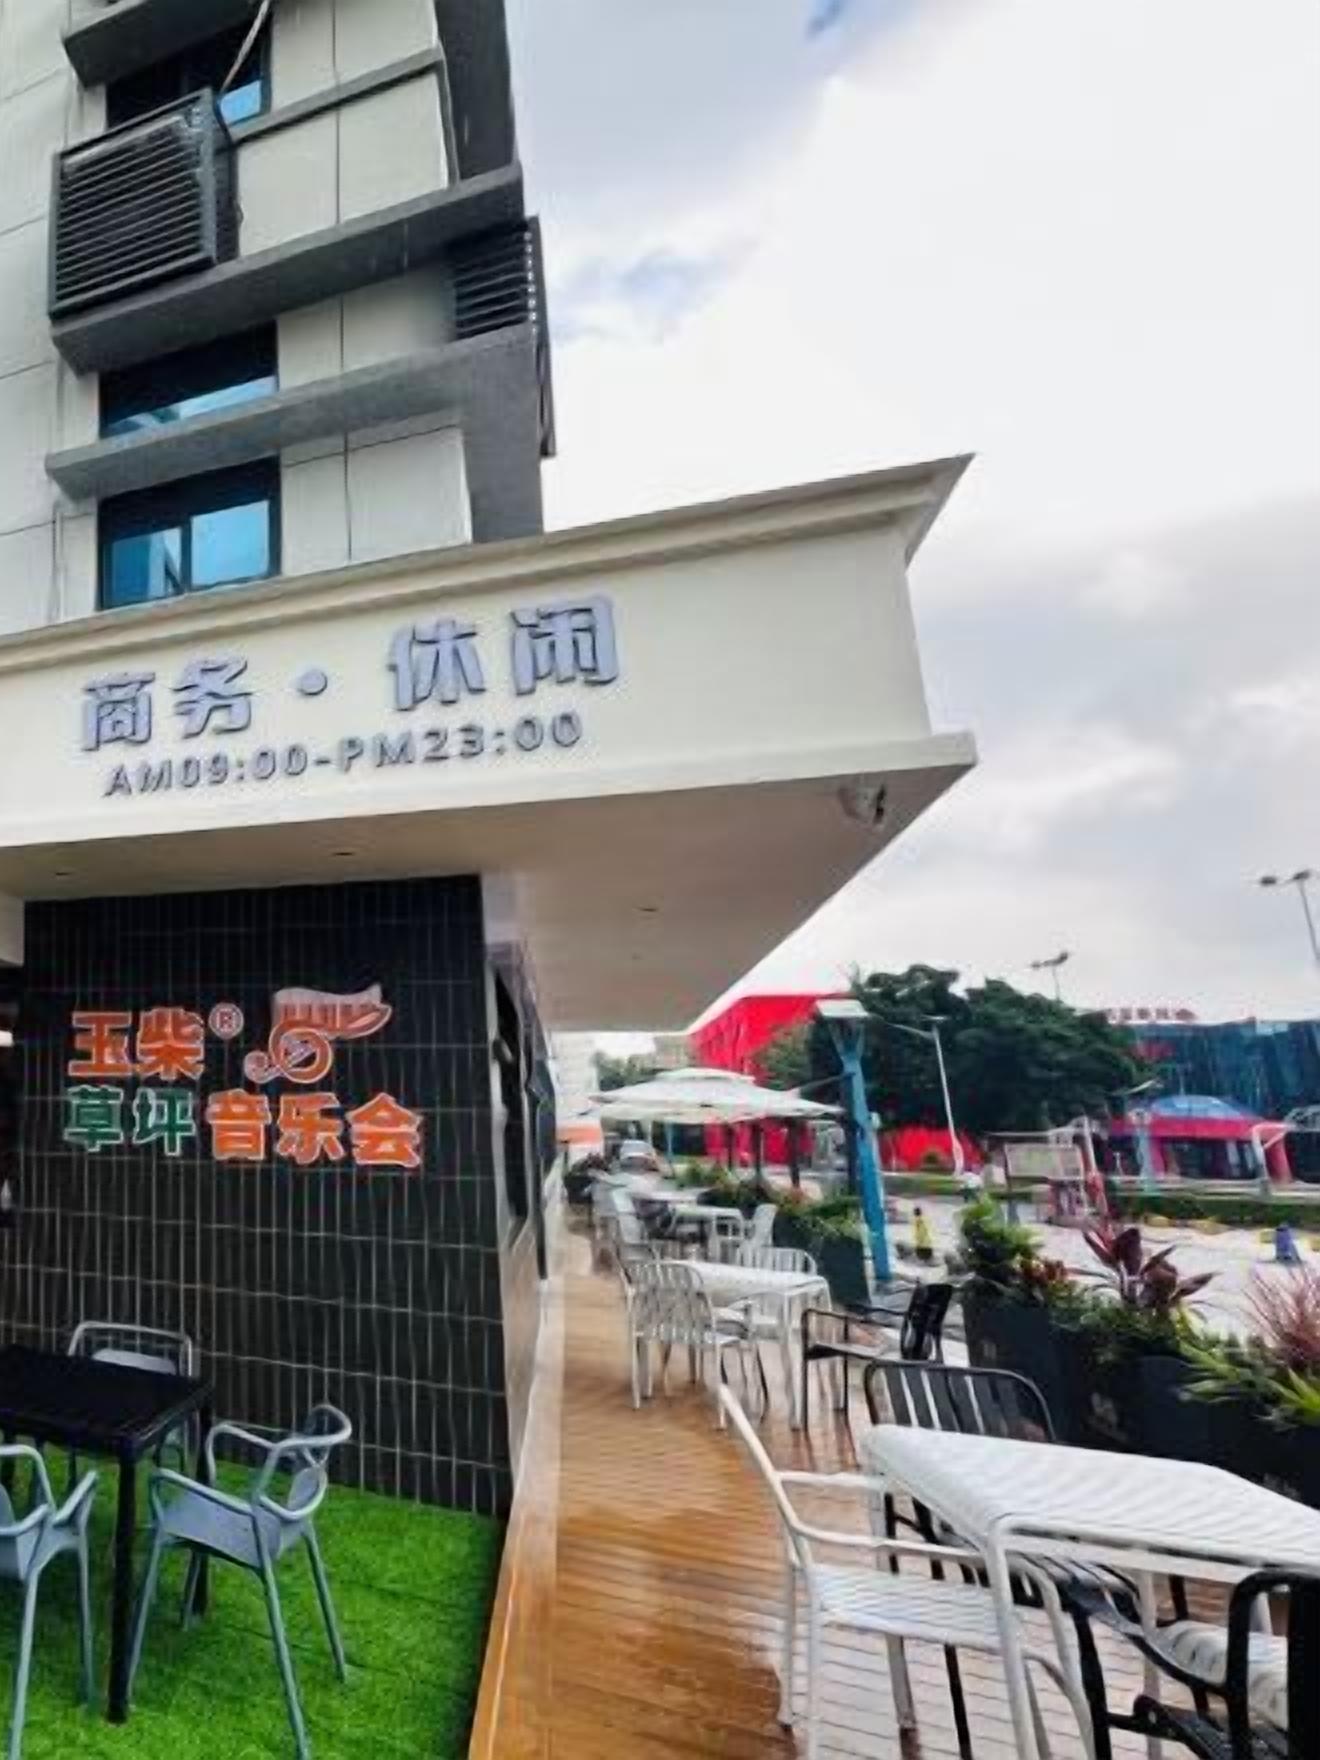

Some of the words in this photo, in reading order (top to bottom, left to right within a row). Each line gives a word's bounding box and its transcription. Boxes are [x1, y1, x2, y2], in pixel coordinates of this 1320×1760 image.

[68, 1006, 206, 1081] 玉柴
[63, 1083, 423, 1168] 草坪音乐会
